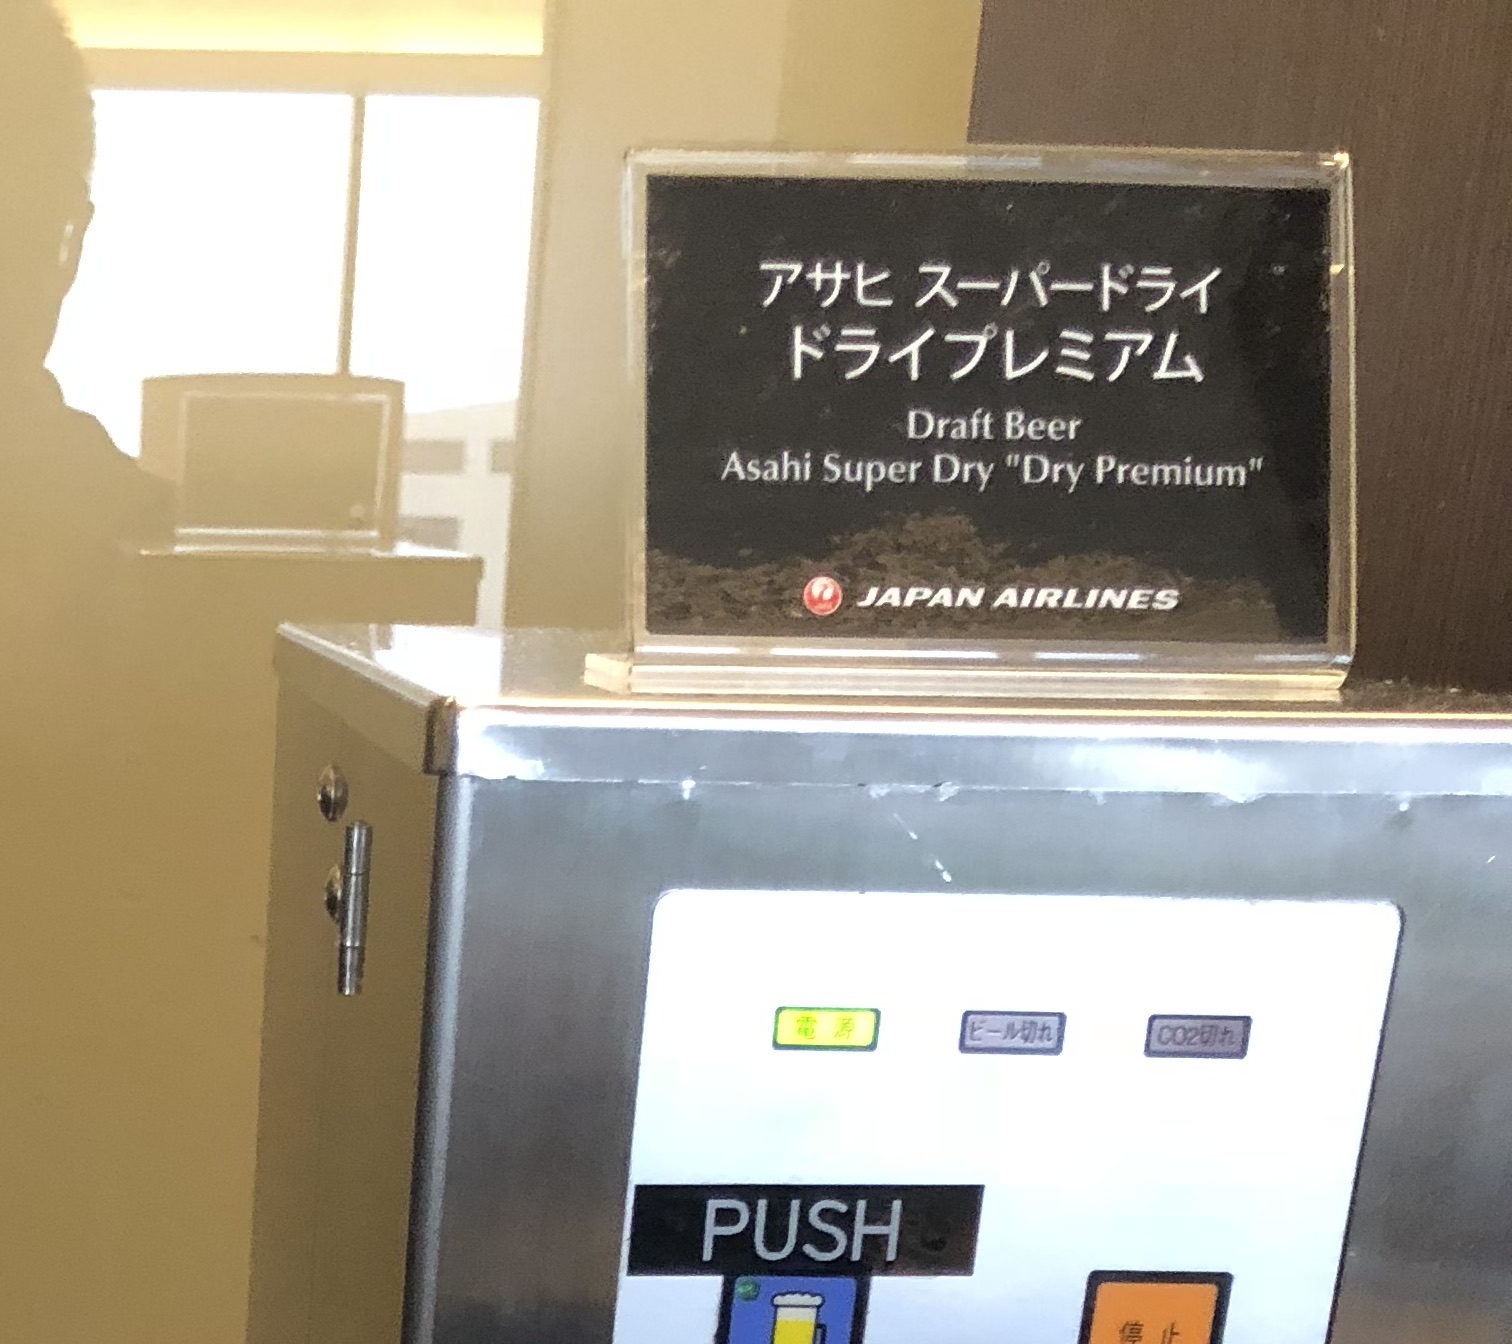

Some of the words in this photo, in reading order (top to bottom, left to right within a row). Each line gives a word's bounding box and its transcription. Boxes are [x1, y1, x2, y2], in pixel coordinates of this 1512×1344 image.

[759, 261, 894, 310] アサヒ
[914, 260, 1222, 314] スーパードライ
[791, 323, 1204, 383] ドライプレミアム
[906, 407, 995, 440] Draft
[1005, 410, 1081, 441] Beer
[722, 453, 812, 483] Asahi
[823, 453, 922, 492] Super
[933, 454, 995, 492] Dry
[1006, 455, 1085, 493] "Dry
[1095, 456, 1263, 488] Premium"
[856, 586, 984, 609] JAPAN
[993, 588, 1180, 612] AIRLINES
[795, 1016, 853, 1040] 電源
[968, 1019, 1053, 1045] ビール切れ
[1157, 1024, 1238, 1048] CO2切れ
[702, 1198, 903, 1263] PUSH
